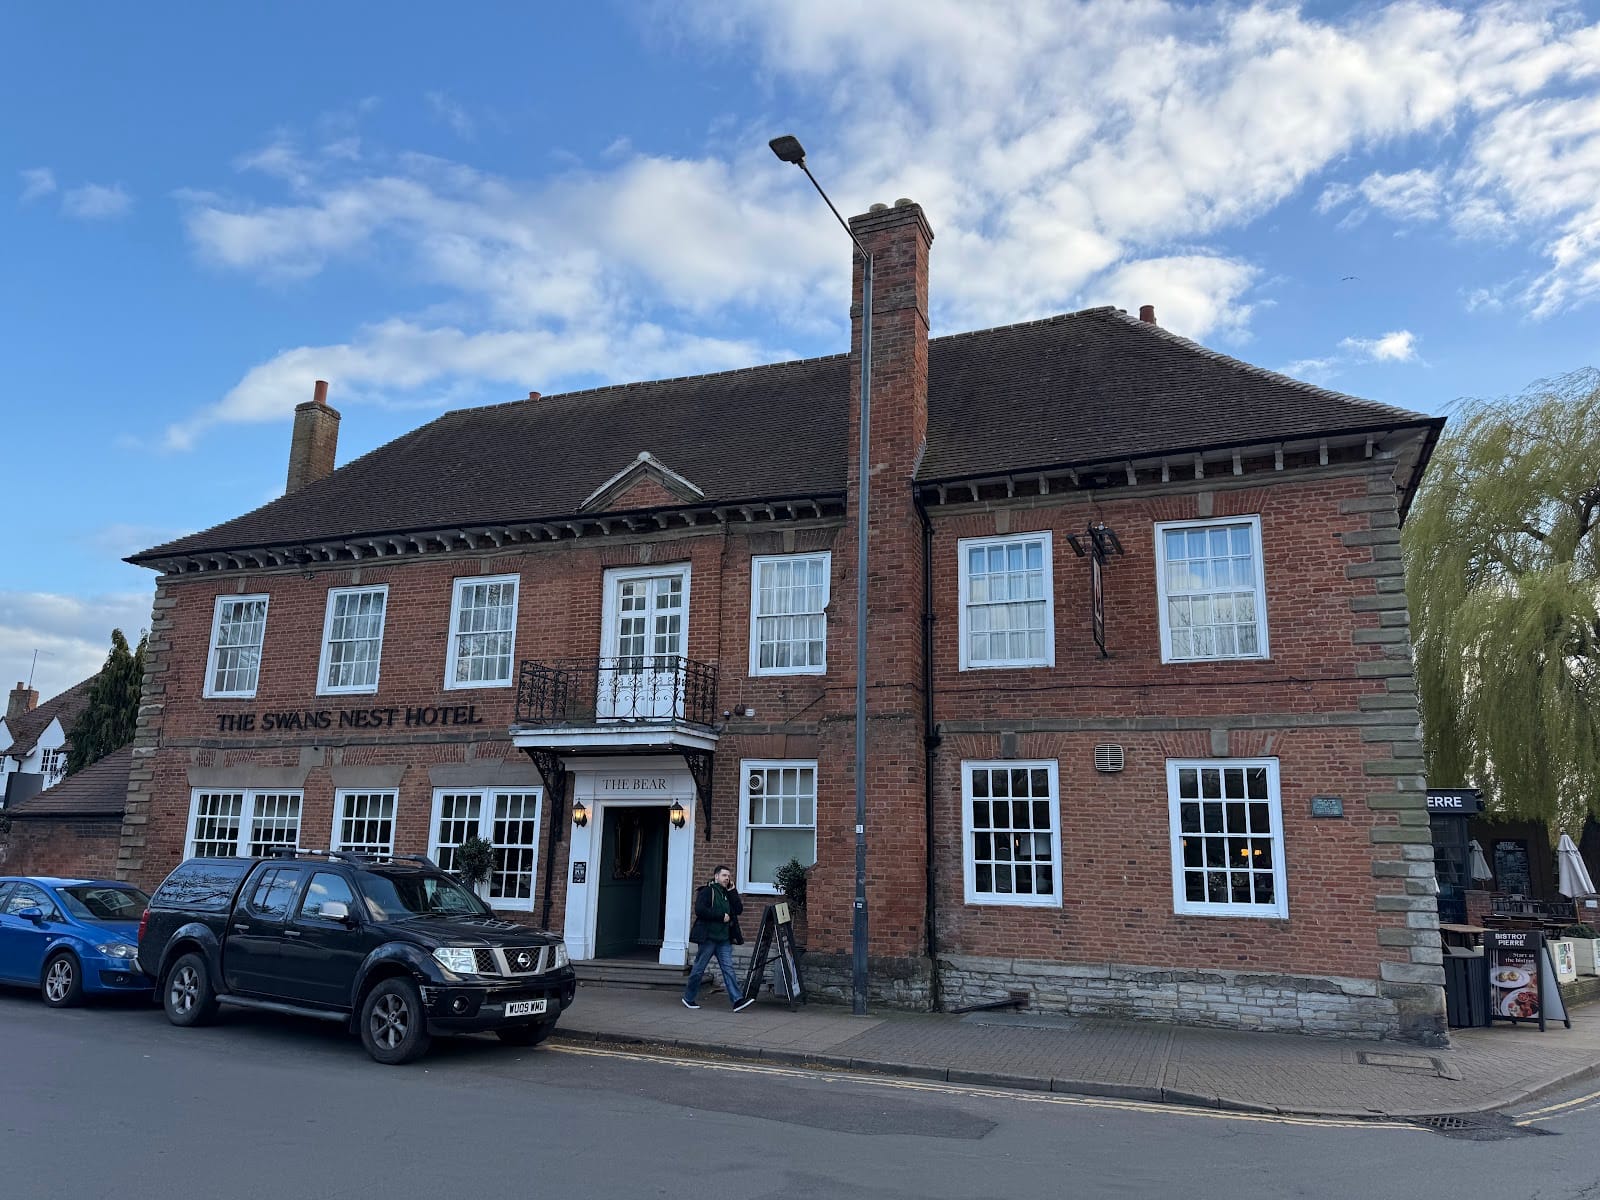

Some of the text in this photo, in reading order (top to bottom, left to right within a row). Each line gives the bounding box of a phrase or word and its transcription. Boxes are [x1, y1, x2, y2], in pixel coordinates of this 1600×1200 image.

[217, 705, 482, 731] THE SWANS NEST HOTEL
[602, 778, 667, 790] THE BEAR
[1427, 796, 1463, 808] ERRE
[509, 1002, 529, 1014] WU09
